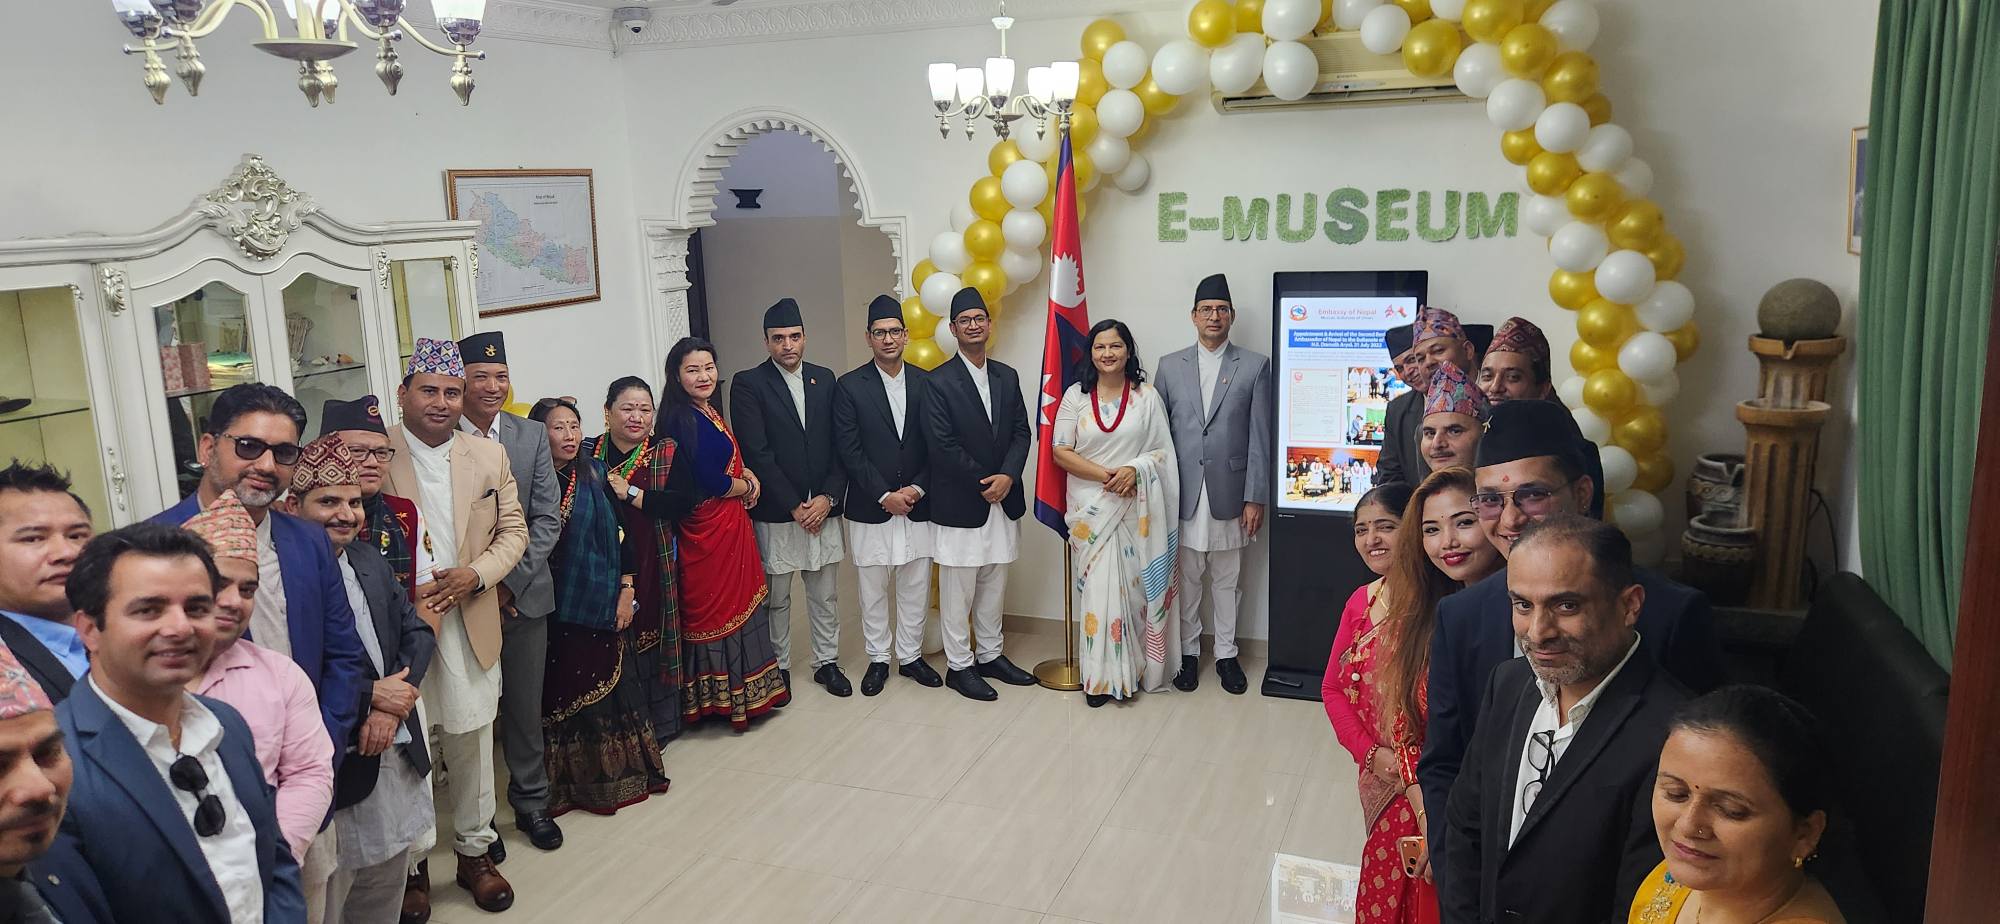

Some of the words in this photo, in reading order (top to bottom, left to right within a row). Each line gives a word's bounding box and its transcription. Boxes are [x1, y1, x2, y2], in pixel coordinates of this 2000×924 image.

[1157, 185, 1519, 245] E-MUSEUM
[1318, 308, 1347, 317] Embassy
[1357, 308, 1377, 317] Nepal
